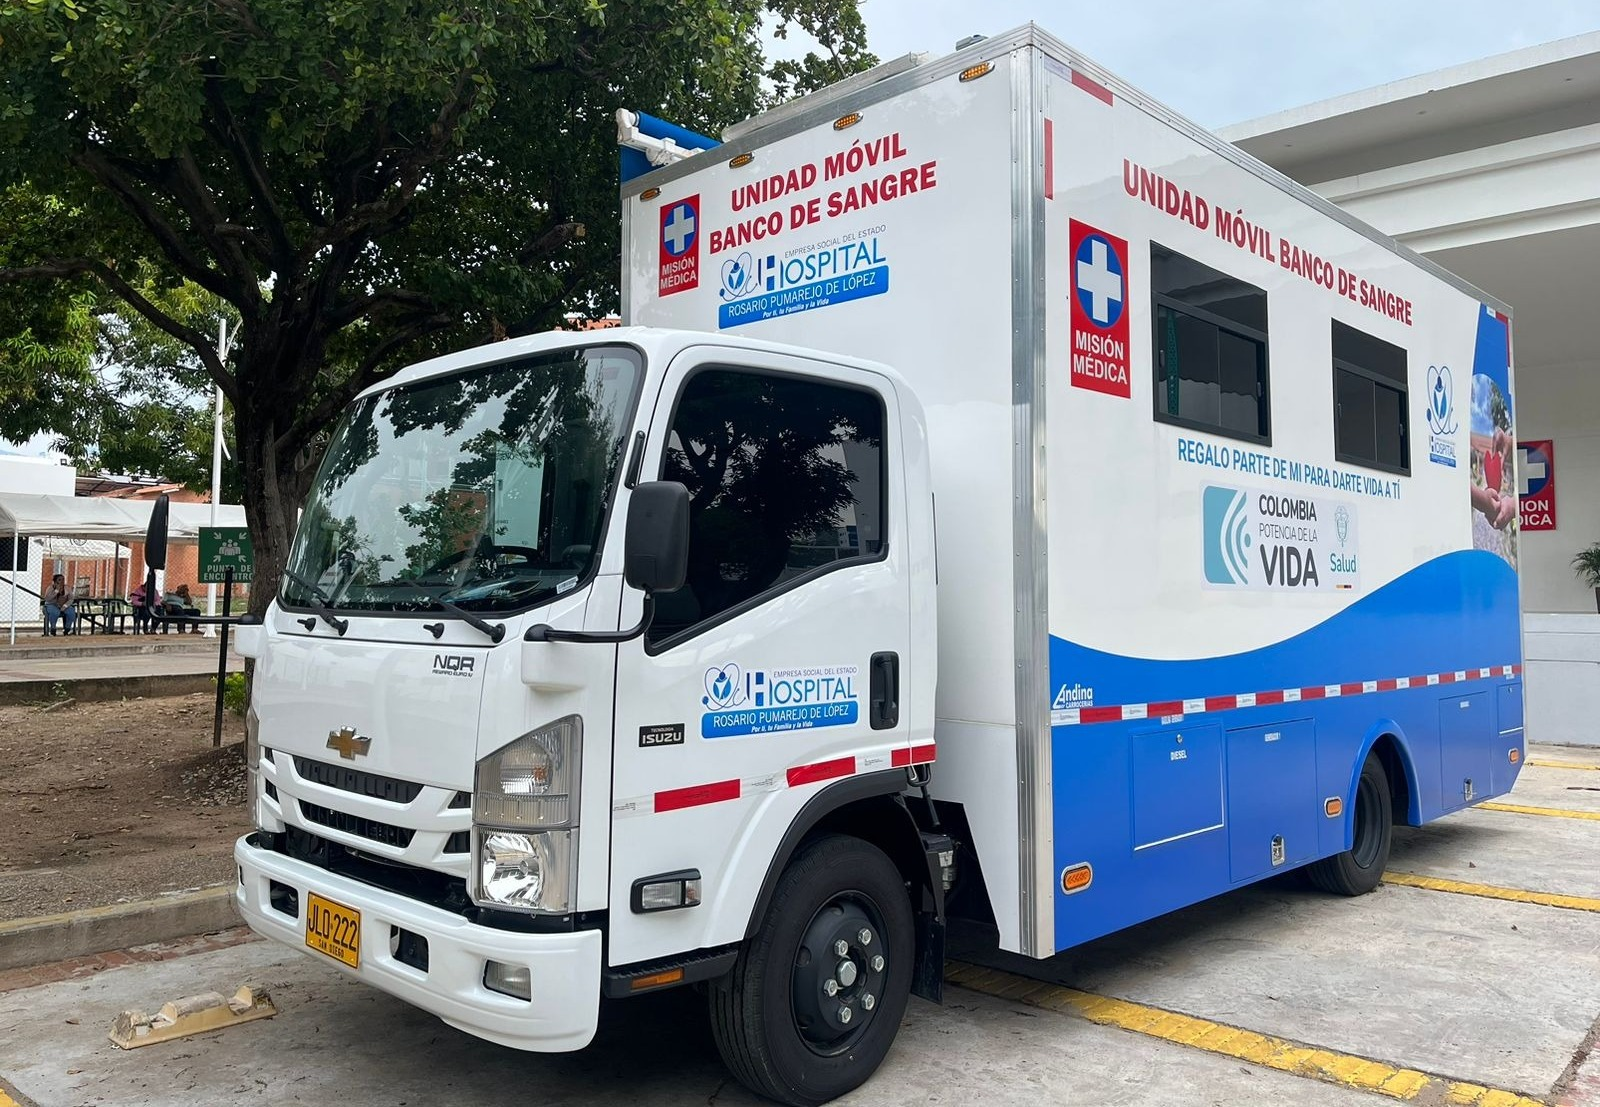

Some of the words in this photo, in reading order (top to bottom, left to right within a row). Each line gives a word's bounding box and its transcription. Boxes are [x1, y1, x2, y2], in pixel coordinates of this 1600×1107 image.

[731, 163, 817, 212] UNIDAD
[824, 132, 907, 182] MÓVIL
[710, 211, 783, 255] BANCO
[790, 201, 821, 230] DE
[827, 161, 937, 218] SANGRE
[784, 244, 816, 259] EMPRESA
[817, 238, 840, 250] SOCIAL
[842, 233, 856, 242] DEL
[858, 224, 887, 239] ESTADO
[1123, 158, 1209, 230] UNIDAD
[1215, 206, 1275, 263] MÓVIL
[1279, 238, 1334, 290] BANCO
[1338, 269, 1357, 301] DE
[1359, 279, 1413, 326] SANGRE
[662, 256, 695, 276] MISIÓN
[758, 238, 887, 292] HOSPITAL
[660, 270, 697, 290] MÉDICA
[728, 299, 768, 318] ROSARIO
[771, 286, 823, 308] PUMAREJO
[826, 282, 840, 296] DE
[843, 272, 876, 291] LÓPEZ
[1075, 329, 1124, 361] MISIÓN
[1073, 353, 1127, 385] MÉDICA
[1178, 438, 1229, 469] REGALO
[1233, 451, 1271, 476] PARTE
[1273, 459, 1288, 479] DE
[1289, 462, 1302, 483] MI
[1305, 465, 1331, 488] PARA
[1333, 472, 1361, 494] DARTE
[1363, 476, 1384, 498] VIDA
[1385, 481, 1392, 498] A
[1259, 494, 1317, 522] COLOMBIA
[1521, 500, 1548, 512] ION
[1259, 523, 1297, 542] POTENCIA
[1298, 526, 1308, 541] DE
[1309, 527, 1318, 542] LA
[241, 564, 251, 573] DE
[1260, 544, 1319, 587] VIDA
[1330, 553, 1357, 573] Salud
[203, 572, 253, 581] ENCUNTRO
[433, 654, 475, 671] NQR
[774, 669, 802, 678] EMPRESA
[803, 668, 822, 676] SOCIAL
[824, 667, 835, 675] DEL
[836, 666, 857, 674] ESTADO
[746, 672, 857, 707] HOSPITAL
[1053, 683, 1093, 709] Andina
[713, 714, 756, 728] ROSARIO
[760, 707, 808, 723] PUMAREJO
[811, 707, 821, 718] DE
[823, 703, 849, 718] LÓPEZ
[642, 732, 682, 744] ISUZU
[1170, 750, 1187, 761] DIESEL
